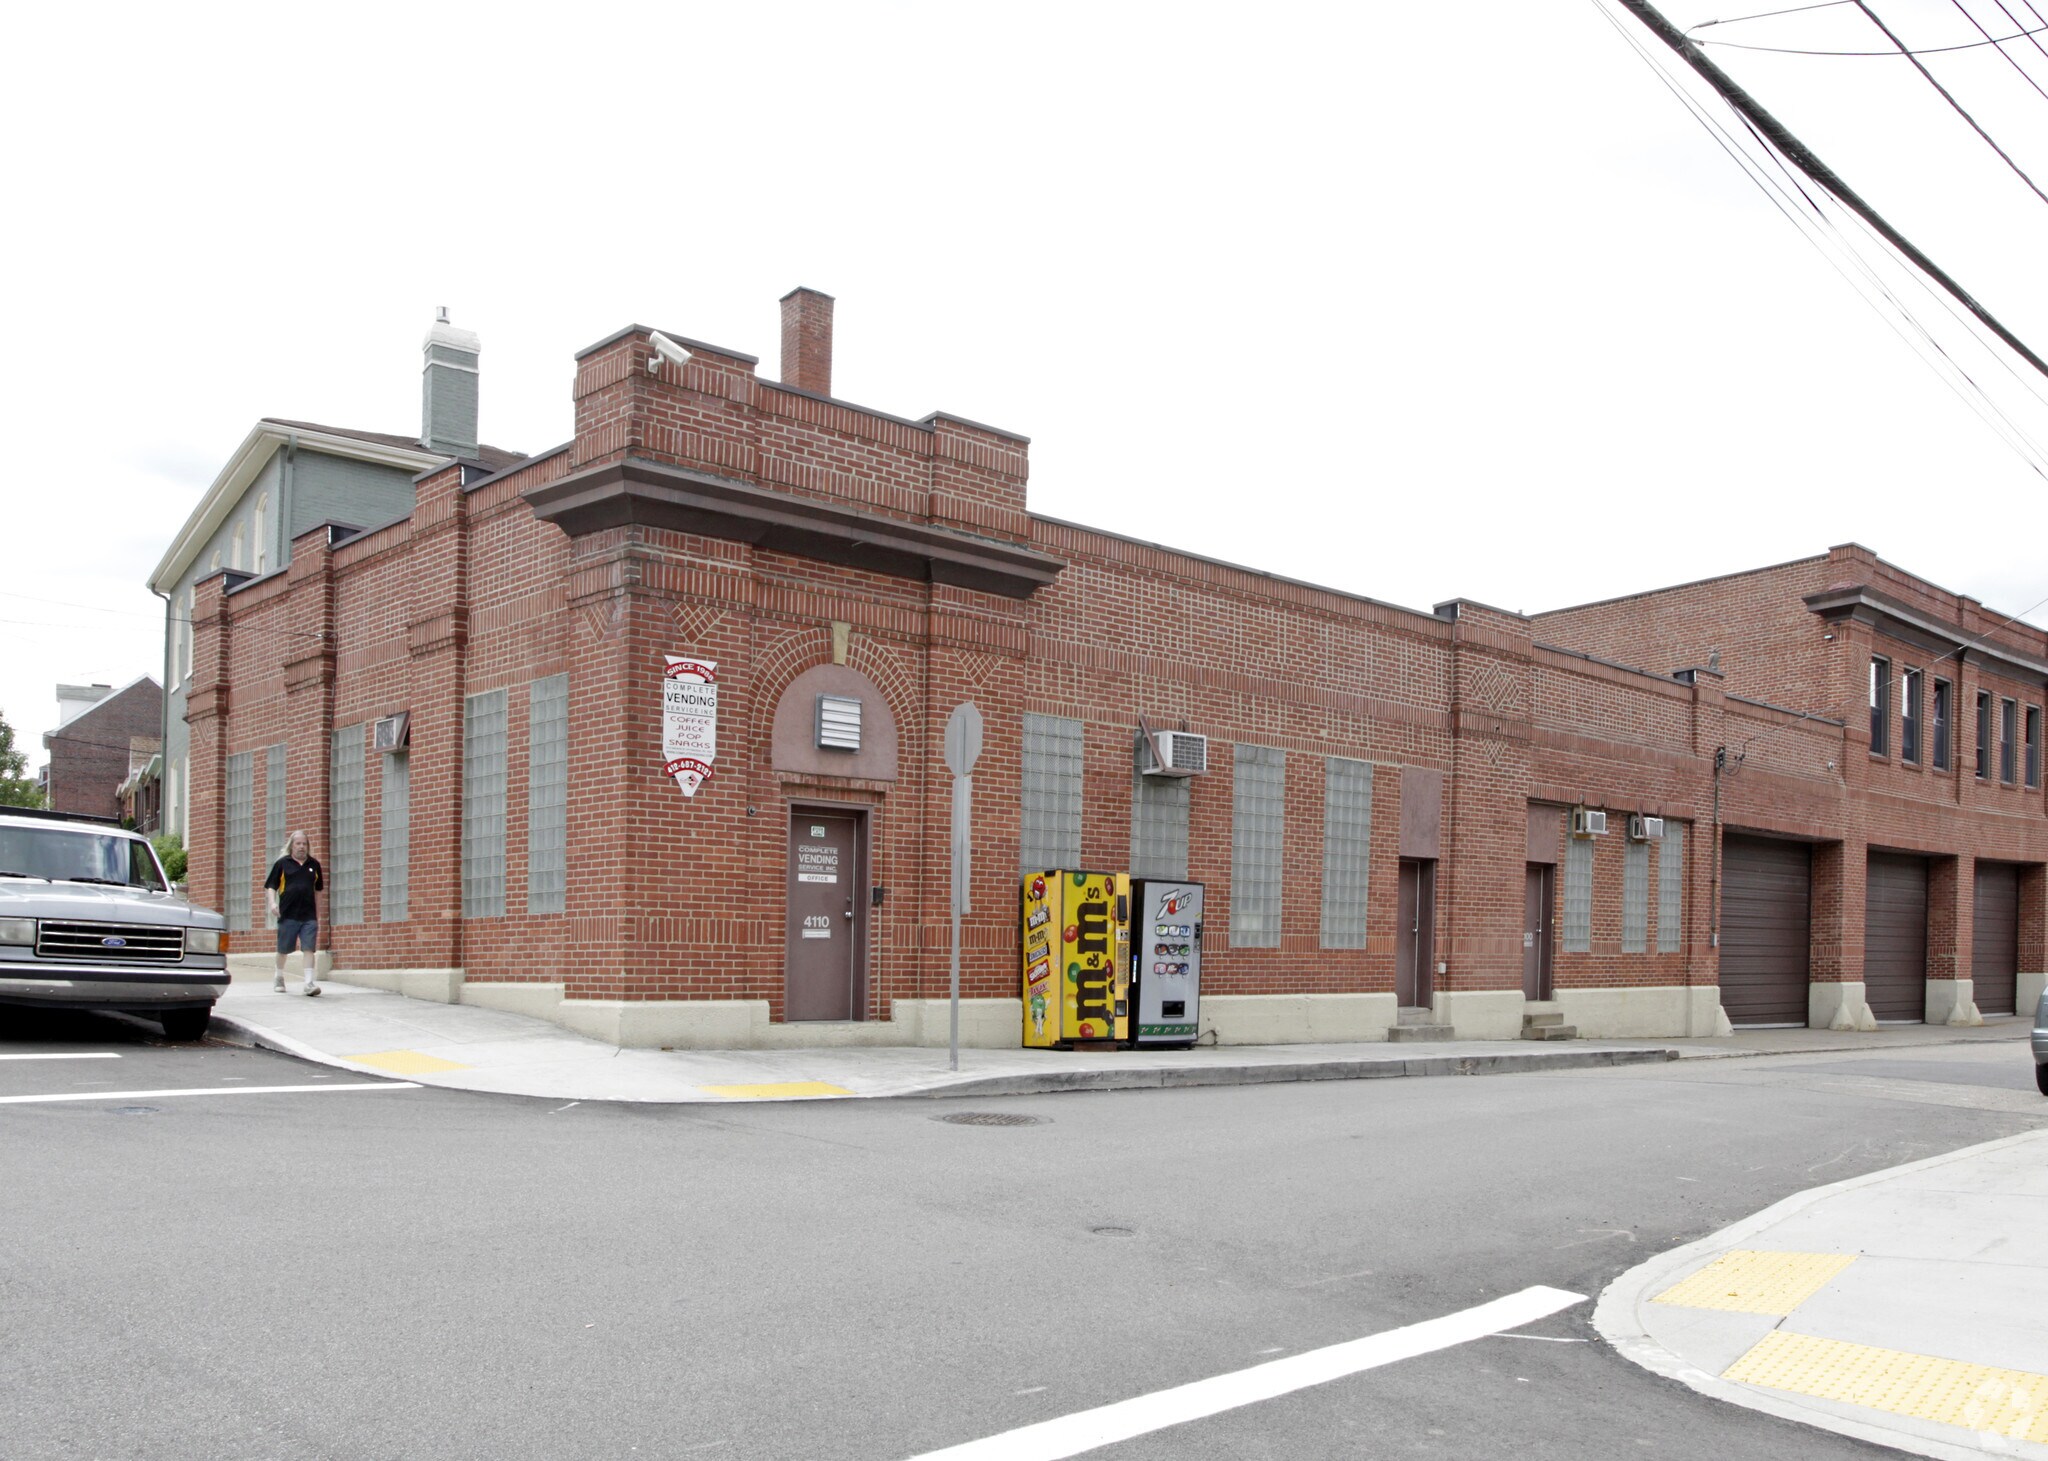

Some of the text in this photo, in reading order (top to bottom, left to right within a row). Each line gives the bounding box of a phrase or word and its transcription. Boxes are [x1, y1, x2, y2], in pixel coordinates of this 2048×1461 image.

[667, 663, 695, 676] SINCE
[666, 682, 715, 695] COMPLETE
[666, 692, 715, 707] VENDING
[666, 705, 699, 714] SERVICE
[670, 716, 711, 725] COFFEE
[676, 724, 705, 733] JUICE
[678, 732, 702, 740] POP
[669, 740, 711, 749] SNACKS
[798, 846, 838, 855] COMPLETE
[798, 853, 838, 865] VENDING
[803, 916, 830, 928] 4110
